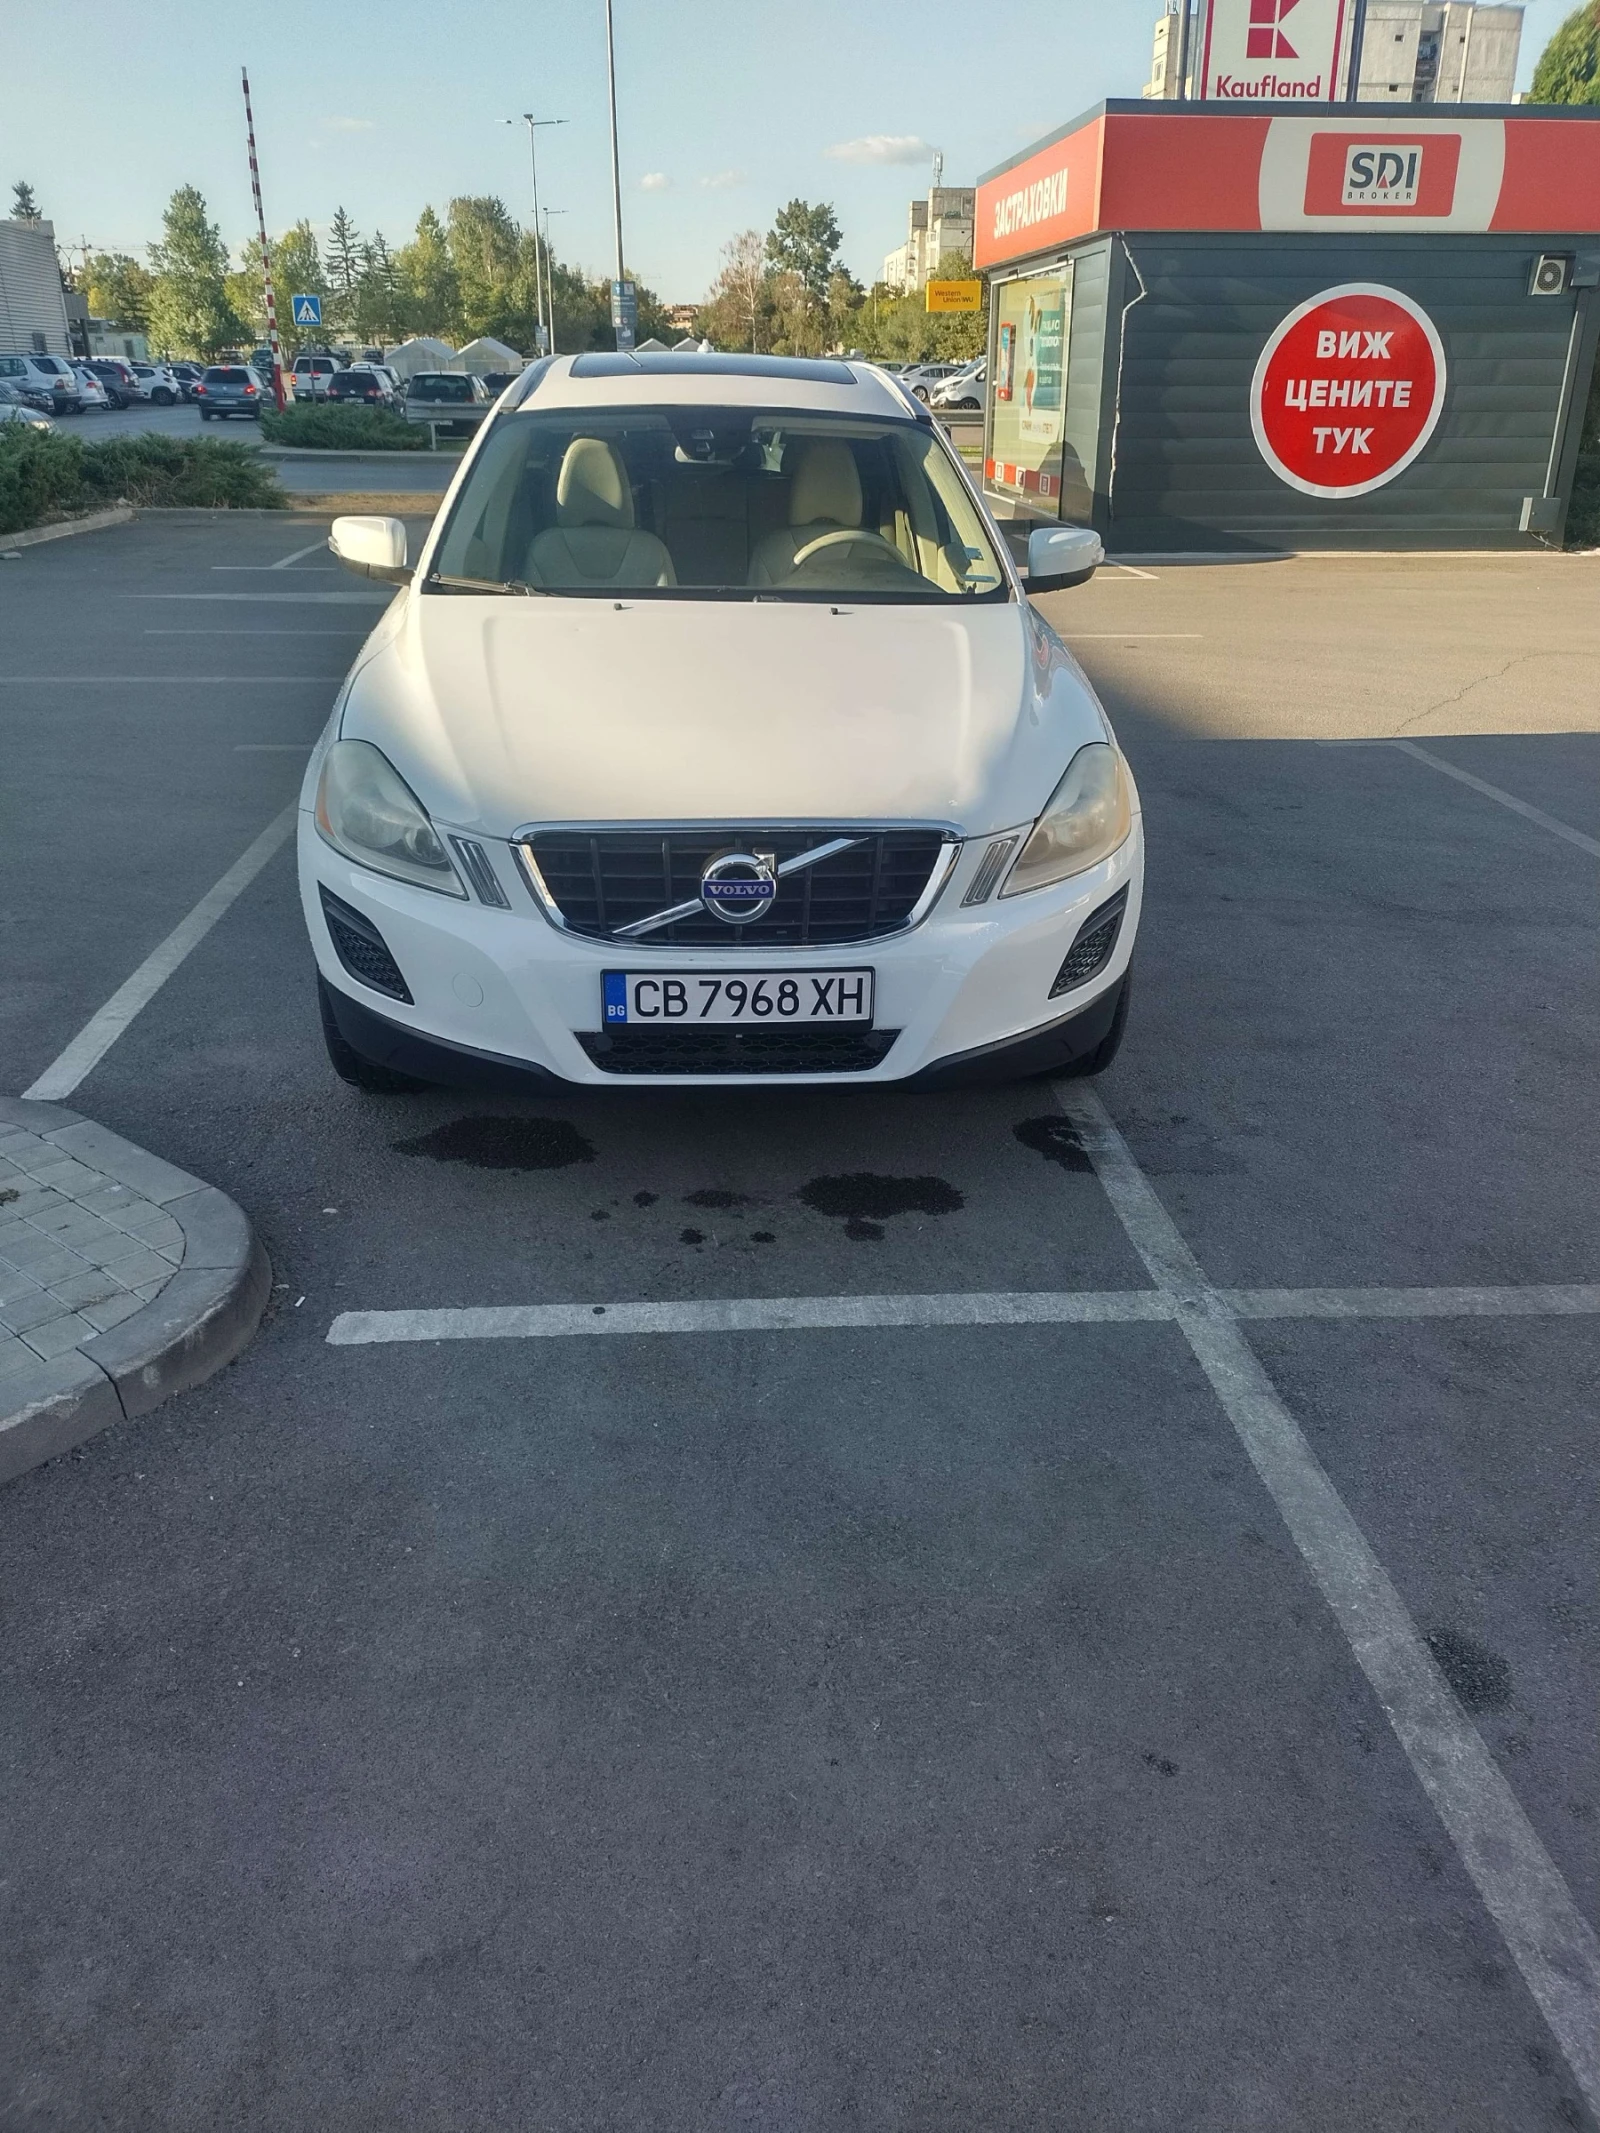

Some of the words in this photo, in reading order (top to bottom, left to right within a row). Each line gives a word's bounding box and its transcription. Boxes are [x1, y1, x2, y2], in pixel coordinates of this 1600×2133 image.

[1216, 75, 1321, 98] Kaufland
[1349, 152, 1417, 189] SDI
[993, 167, 1069, 240] ЗАСТРАХОВКИ
[1347, 191, 1412, 200] BROKER
[1316, 330, 1395, 359] ВИЖ
[1284, 379, 1413, 412] ЦЕНИТЕ
[1312, 426, 1375, 455] ТУК
[708, 885, 770, 895] VOLVO
[607, 1005, 626, 1017] BG
[634, 980, 689, 1018] CB
[698, 979, 800, 1018] 7968
[810, 977, 864, 1016] XH
